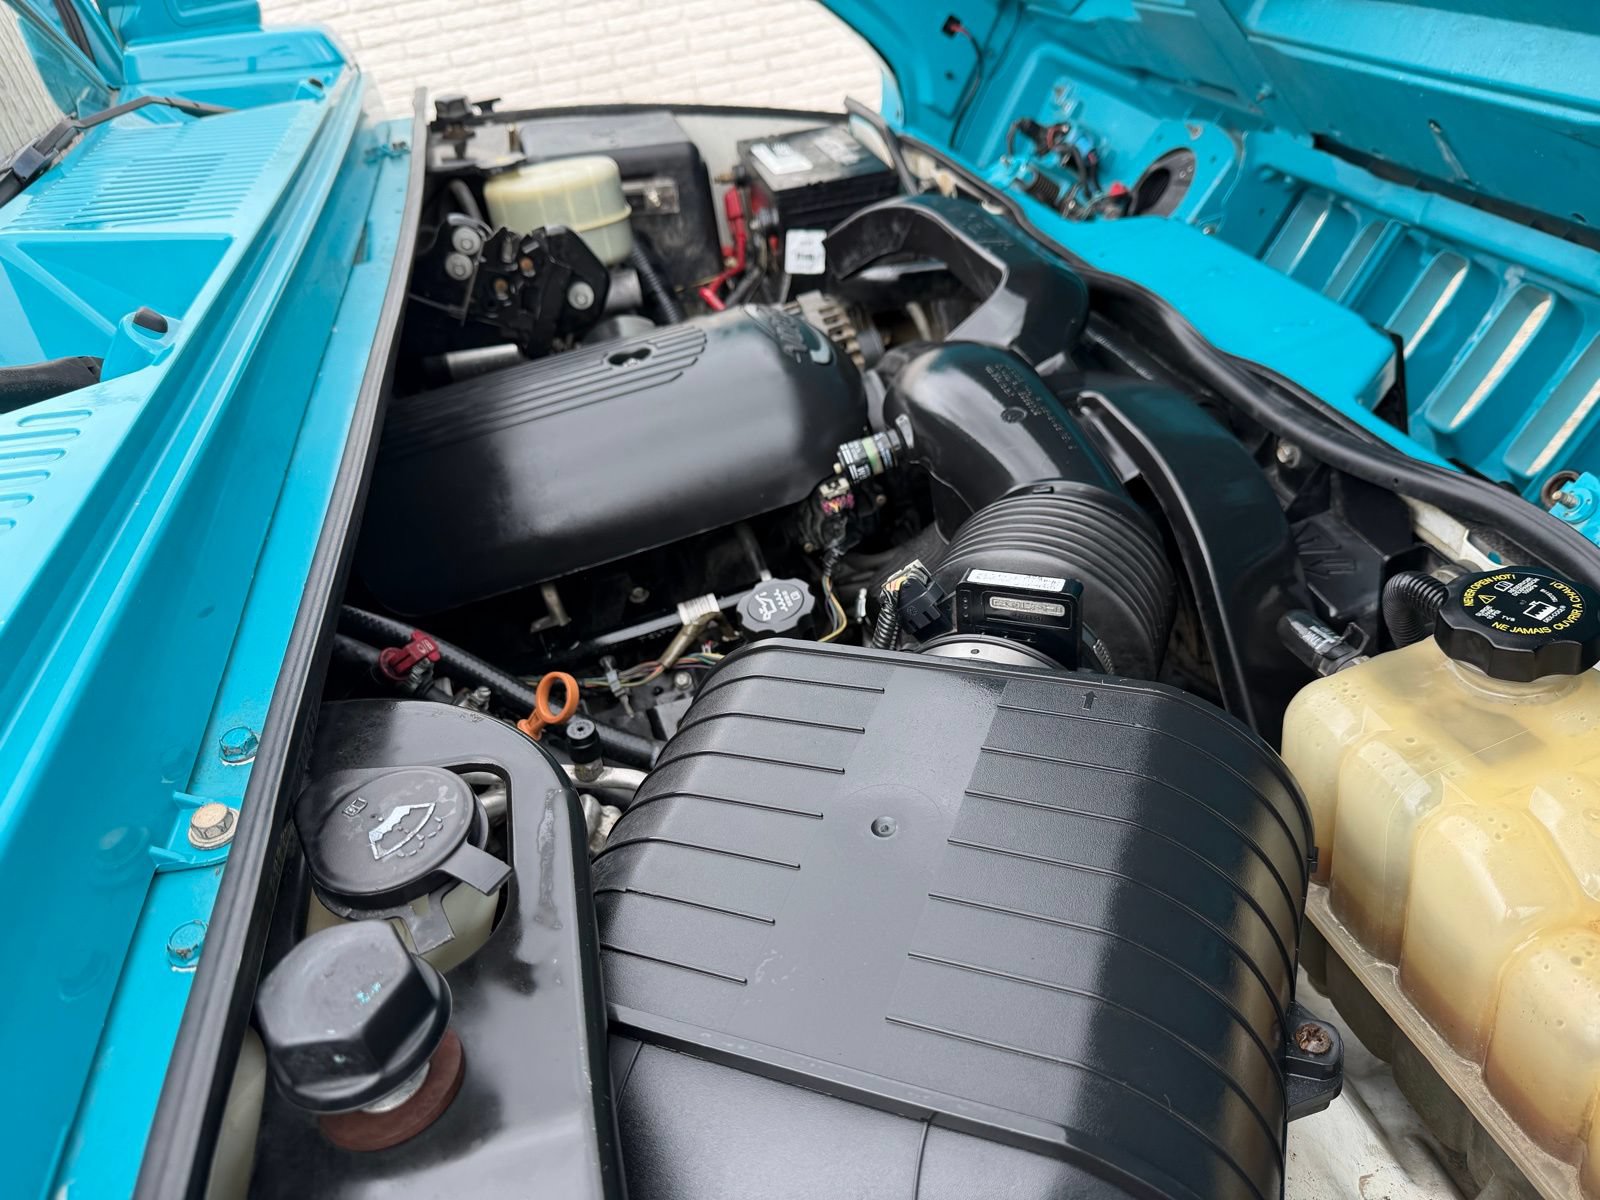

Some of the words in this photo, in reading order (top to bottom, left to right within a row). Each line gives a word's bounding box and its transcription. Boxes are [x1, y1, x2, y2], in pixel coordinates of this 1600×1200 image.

[1472, 577, 1492, 593] OPEN
[1493, 573, 1516, 581] HOT!
[1492, 621, 1509, 632] NE
[1510, 626, 1552, 635] JAMAIS
[1553, 609, 1583, 631] OUVRIR
